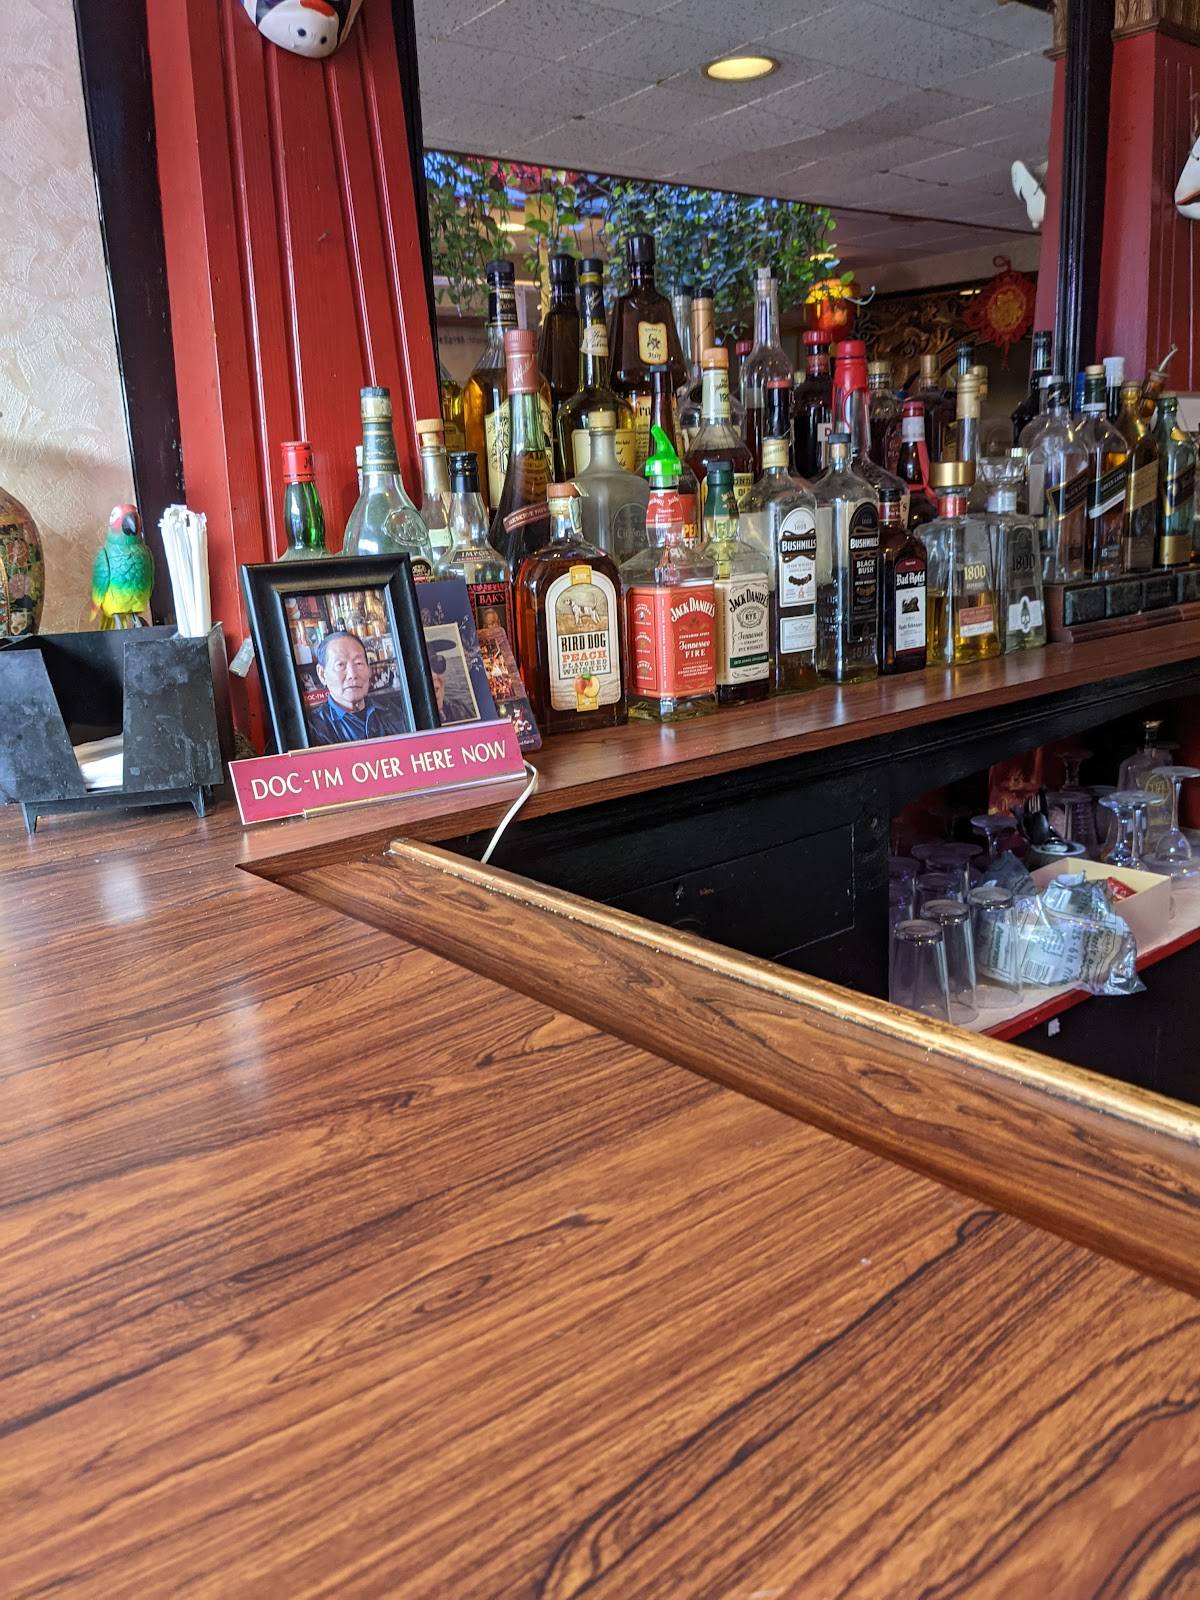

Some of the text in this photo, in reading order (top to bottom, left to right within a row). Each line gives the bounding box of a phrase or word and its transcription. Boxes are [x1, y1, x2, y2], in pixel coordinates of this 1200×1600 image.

[782, 539, 816, 552] BUSHMILLS
[850, 536, 879, 549] BUSHMILLS
[856, 560, 875, 569] BLACK
[1012, 553, 1036, 571] 1800
[858, 567, 874, 575] BUSH
[964, 564, 986, 580] 1800
[896, 573, 909, 585] Bad
[670, 601, 690, 622] JACK
[689, 597, 716, 618] DANIEL'S
[729, 593, 747, 613] JACK
[745, 612, 757, 620] RYE
[561, 632, 606, 652] BIRD DOG
[678, 639, 711, 651] Tennessee
[562, 650, 607, 663] PEACH
[685, 648, 706, 659] FIRE
[562, 659, 607, 669] FLAVORED
[563, 665, 607, 675] WHISKEY
[351, 756, 404, 784] OVER
[411, 748, 455, 774] HERE
[461, 739, 507, 765] NOW
